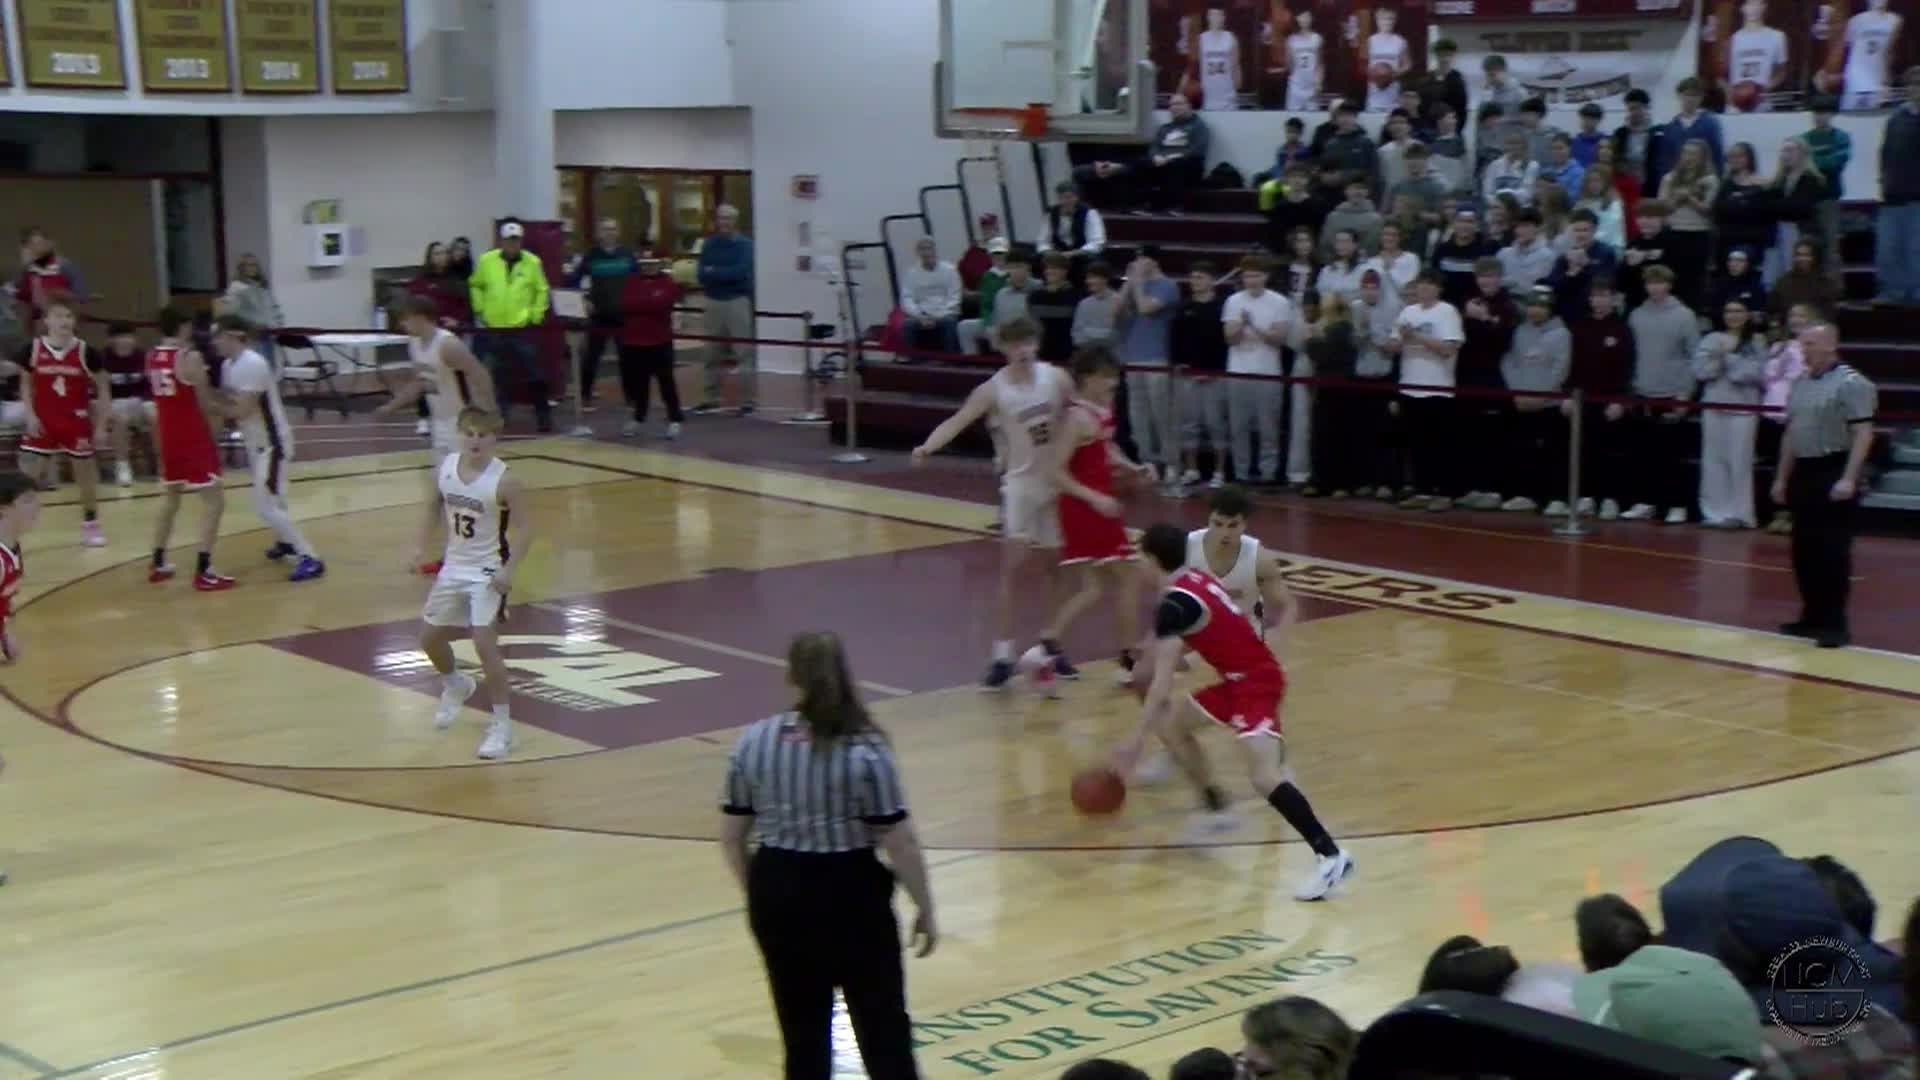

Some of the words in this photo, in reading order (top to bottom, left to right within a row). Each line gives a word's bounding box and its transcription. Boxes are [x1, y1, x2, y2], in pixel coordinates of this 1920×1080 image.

[453, 512, 476, 540] 13
[1276, 558, 1517, 611] ERS
[911, 928, 1285, 1049] NSTITUTION
[943, 1024, 1106, 1075] FOR
